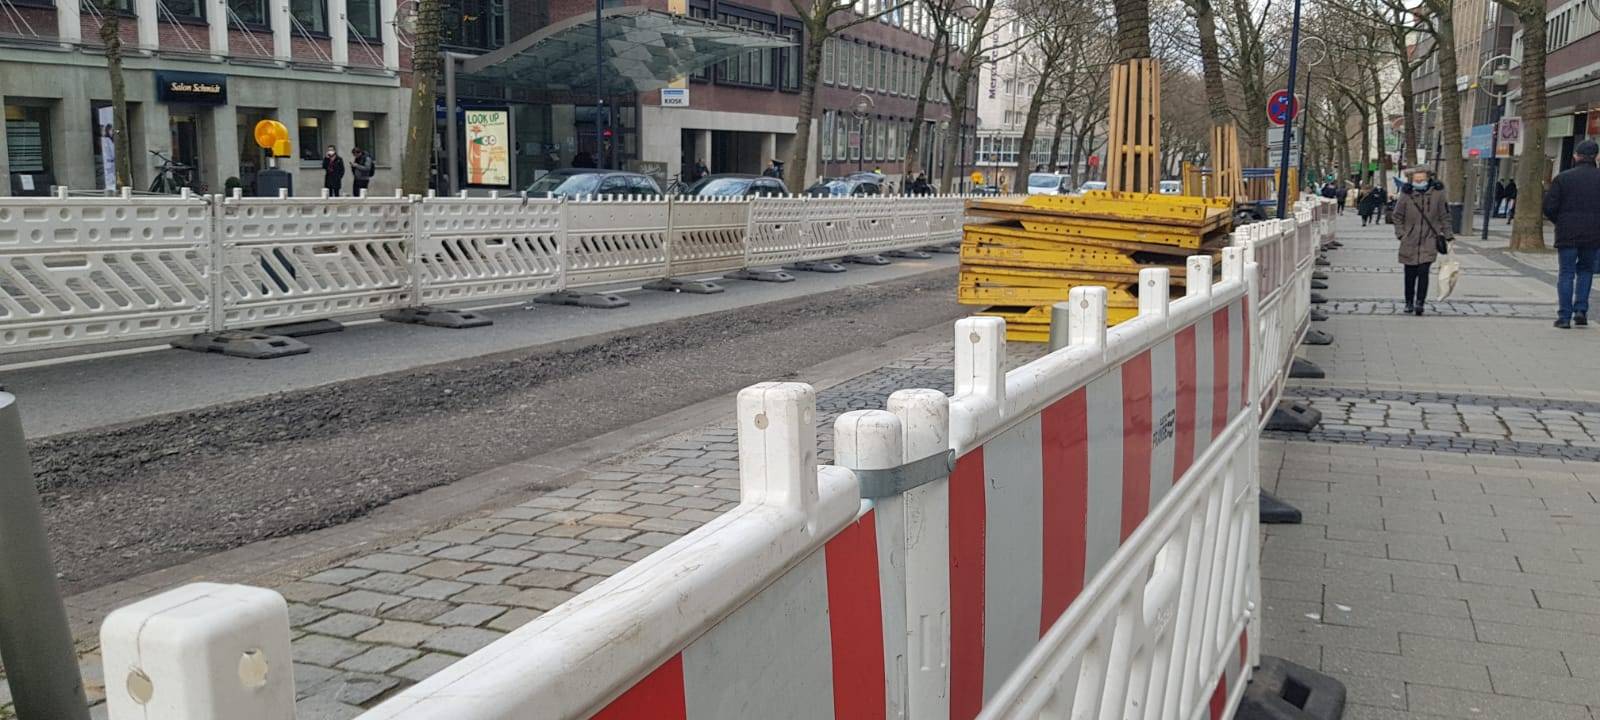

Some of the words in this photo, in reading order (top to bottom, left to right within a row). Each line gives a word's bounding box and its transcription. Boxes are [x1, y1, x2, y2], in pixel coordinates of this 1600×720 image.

[170, 82, 192, 92] Salon
[192, 83, 221, 93] Schmidt
[467, 114, 488, 124] LOOK
[489, 113, 499, 122] UP
